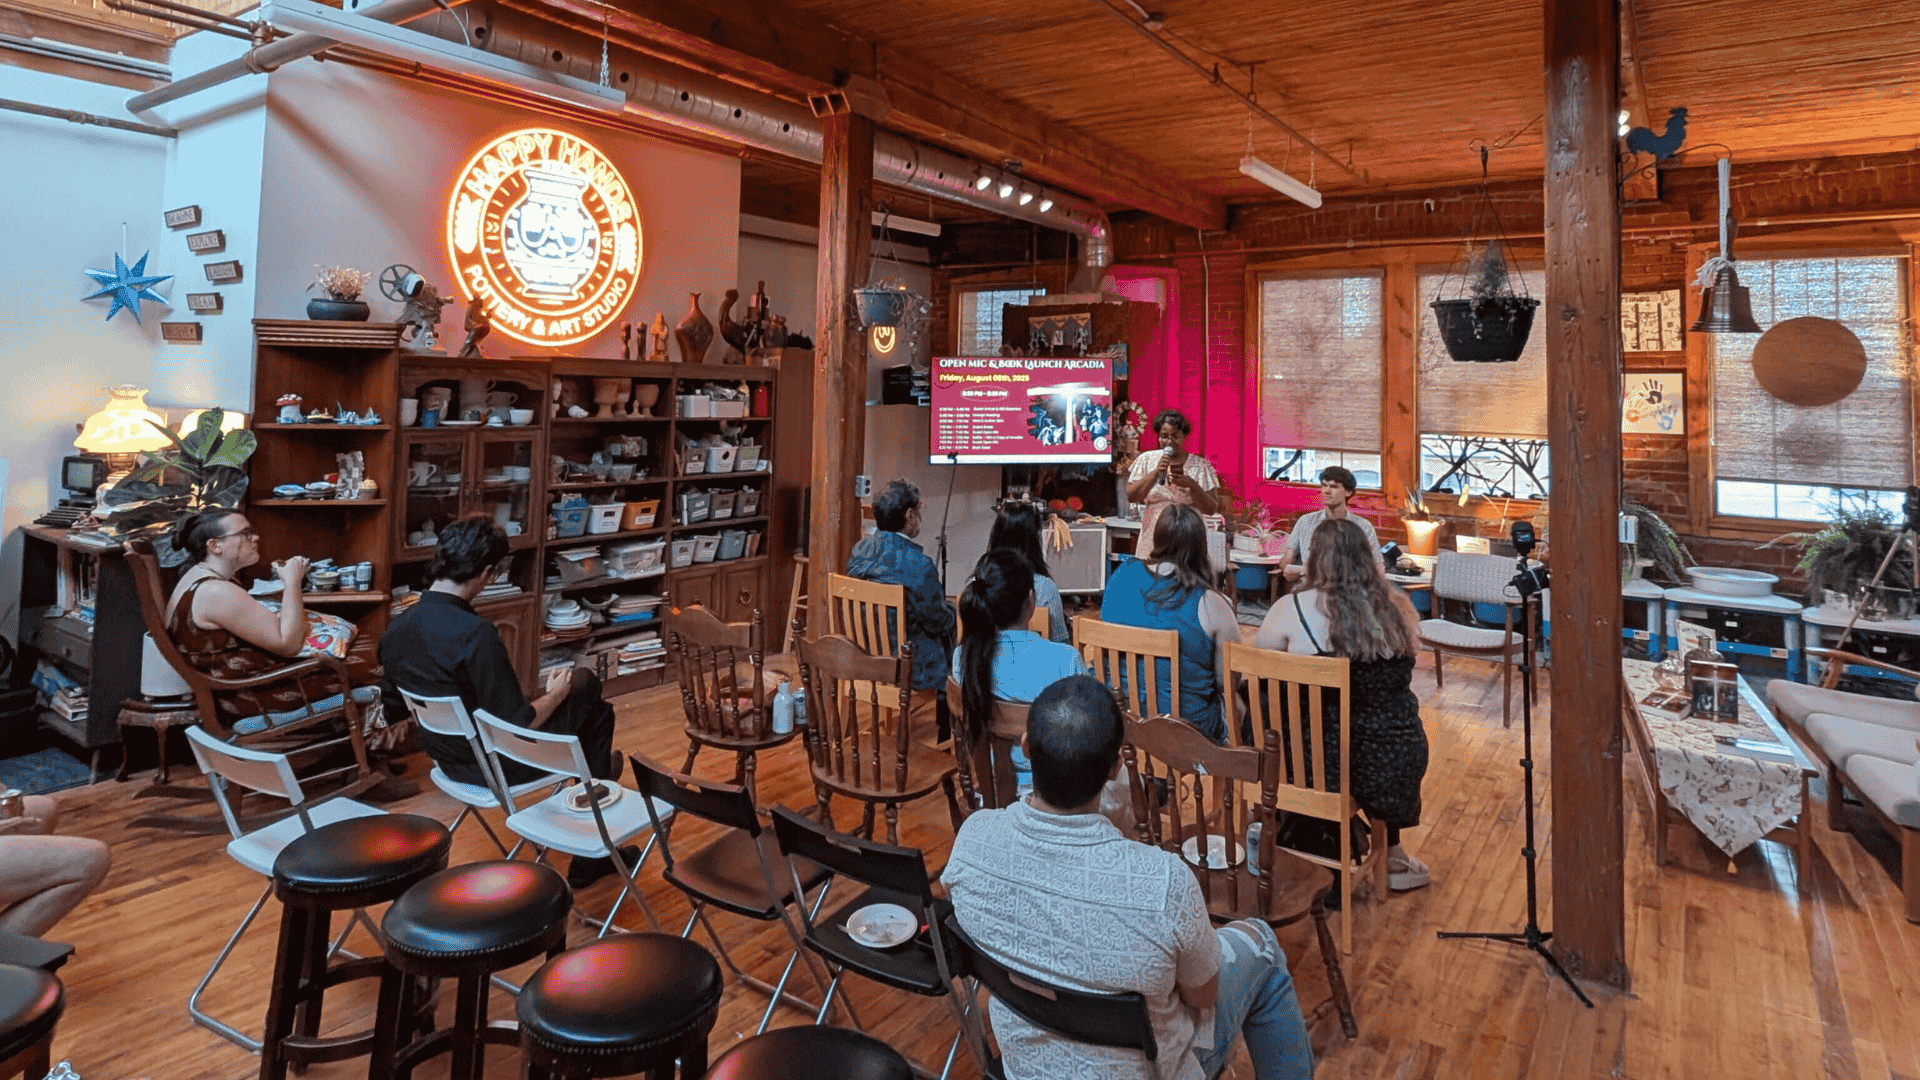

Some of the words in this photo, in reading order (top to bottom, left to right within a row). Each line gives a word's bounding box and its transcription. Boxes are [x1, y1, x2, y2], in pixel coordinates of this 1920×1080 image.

[465, 133, 553, 200] HAPPY
[558, 137, 632, 222] HANDS
[465, 264, 531, 330] POTTERY
[531, 320, 546, 336] &
[548, 319, 582, 337] ART
[581, 277, 627, 328] STUDIO
[940, 359, 967, 368] OPEN
[968, 359, 988, 368] MIC
[989, 359, 999, 369] &
[999, 359, 1023, 368] BOOK
[1025, 359, 1062, 370] LAUNCH
[1064, 359, 1105, 370] ARCADIA
[940, 374, 965, 383] Friday,
[966, 374, 992, 384] August
